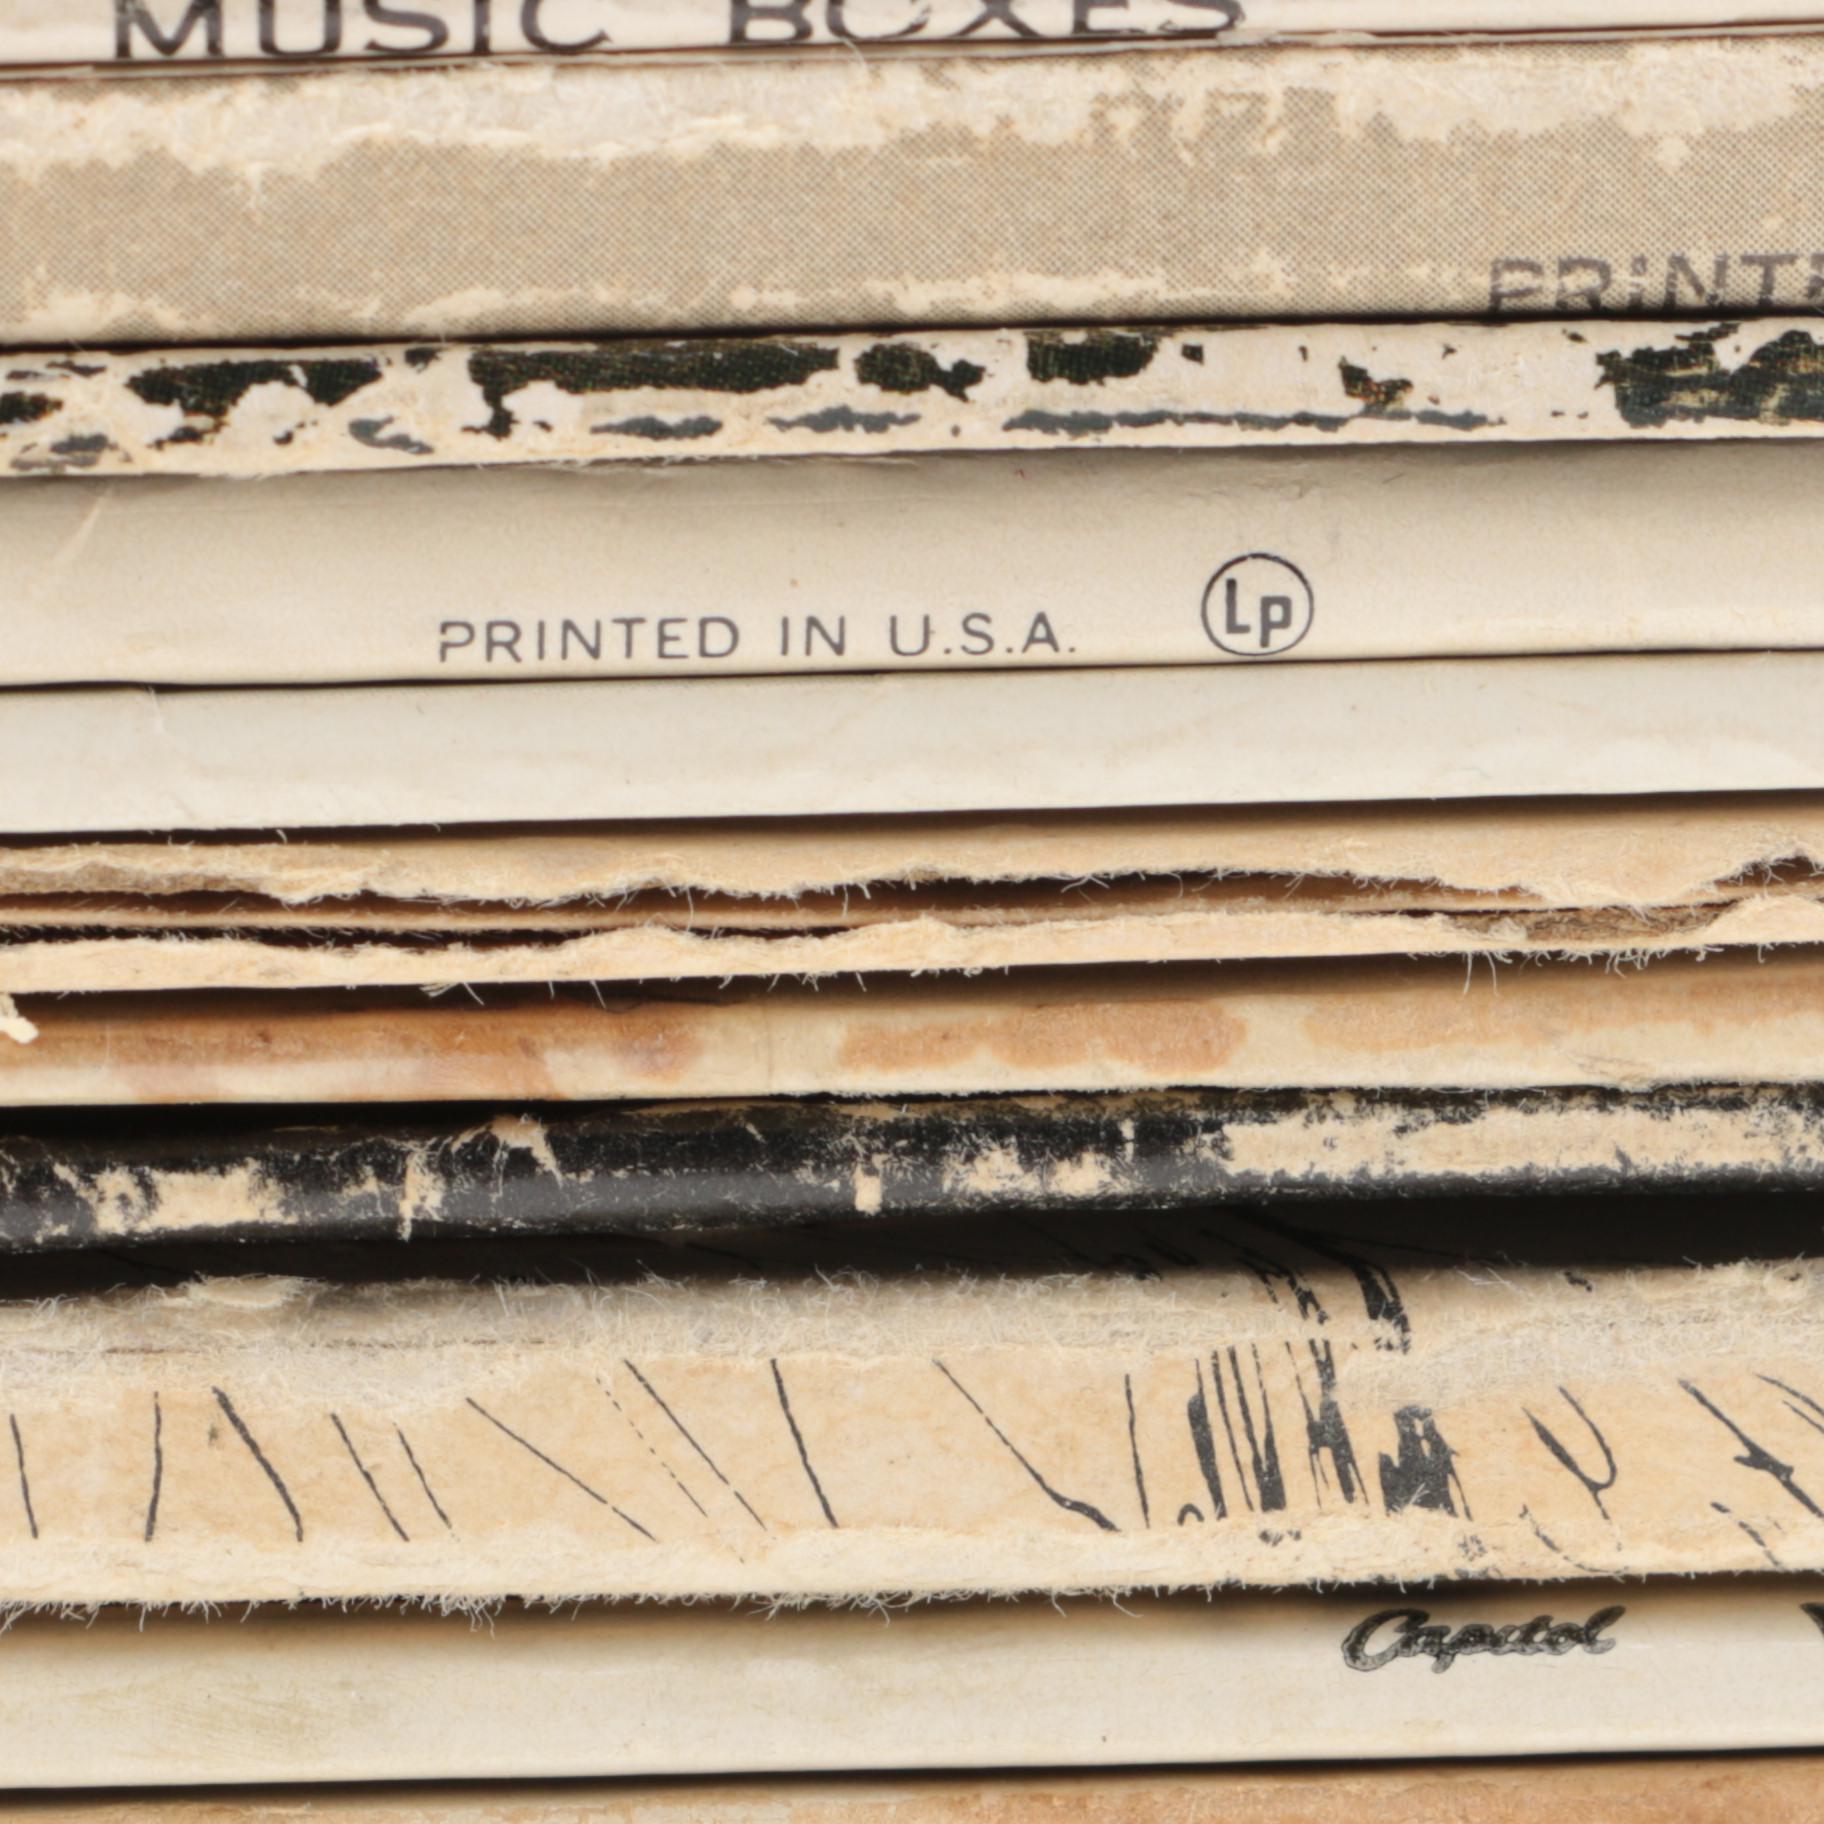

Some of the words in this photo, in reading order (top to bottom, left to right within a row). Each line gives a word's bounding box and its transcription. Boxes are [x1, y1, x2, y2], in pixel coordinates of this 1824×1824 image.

[114, 0, 613, 59] MUSIC
[438, 616, 740, 662] PRINTED
[779, 613, 847, 658] IN
[889, 611, 1076, 656] U.S.A.
